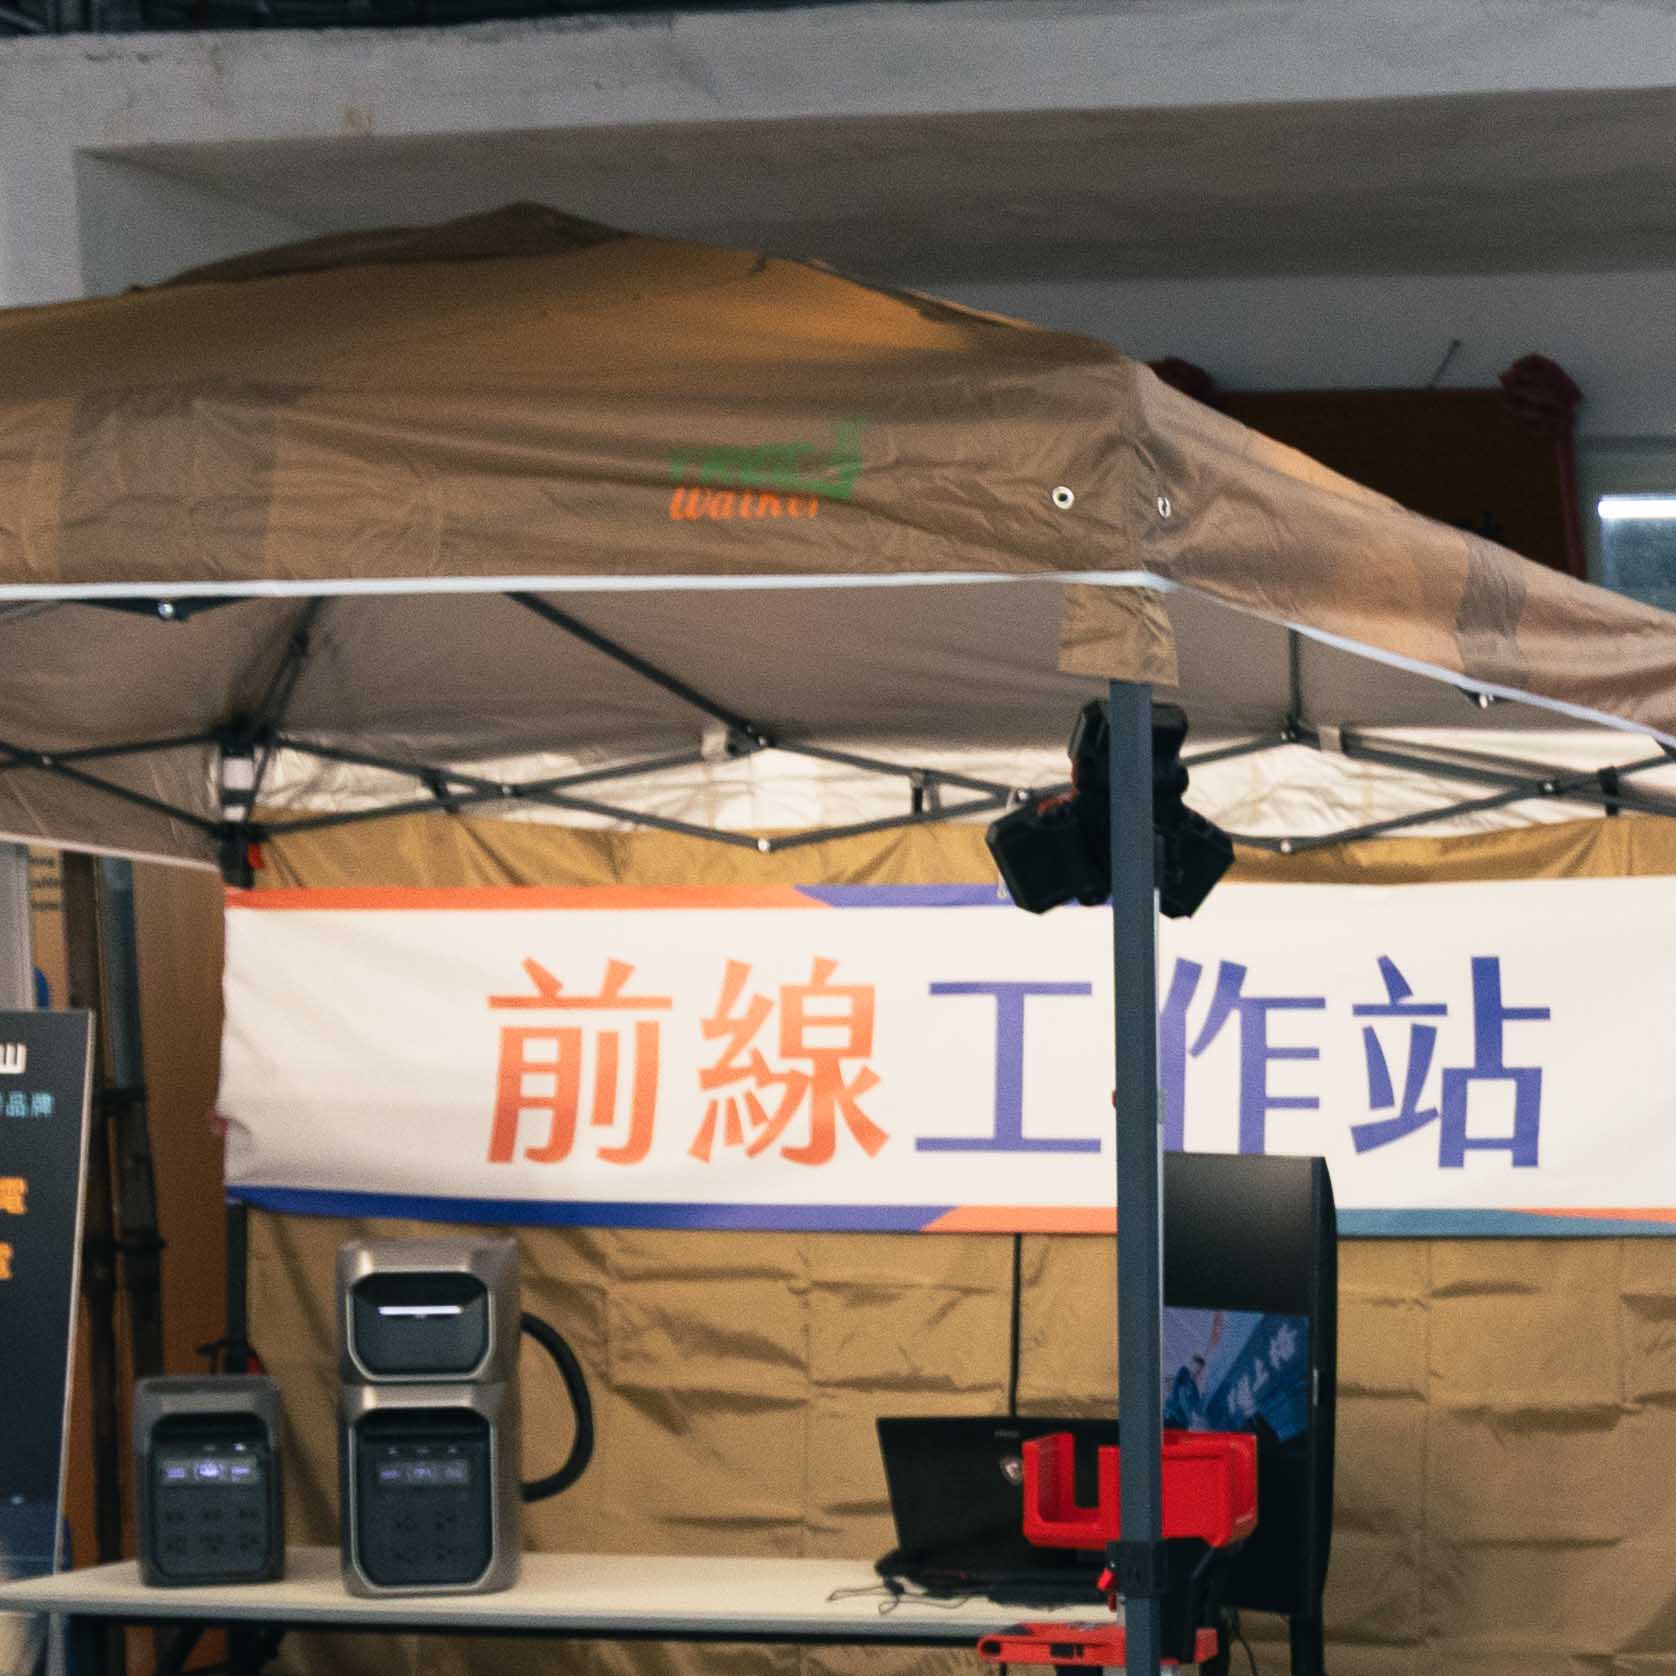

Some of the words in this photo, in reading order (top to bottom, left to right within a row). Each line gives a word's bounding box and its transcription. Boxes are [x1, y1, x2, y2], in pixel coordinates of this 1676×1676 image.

[487, 955, 1551, 1169] 前線工作站
